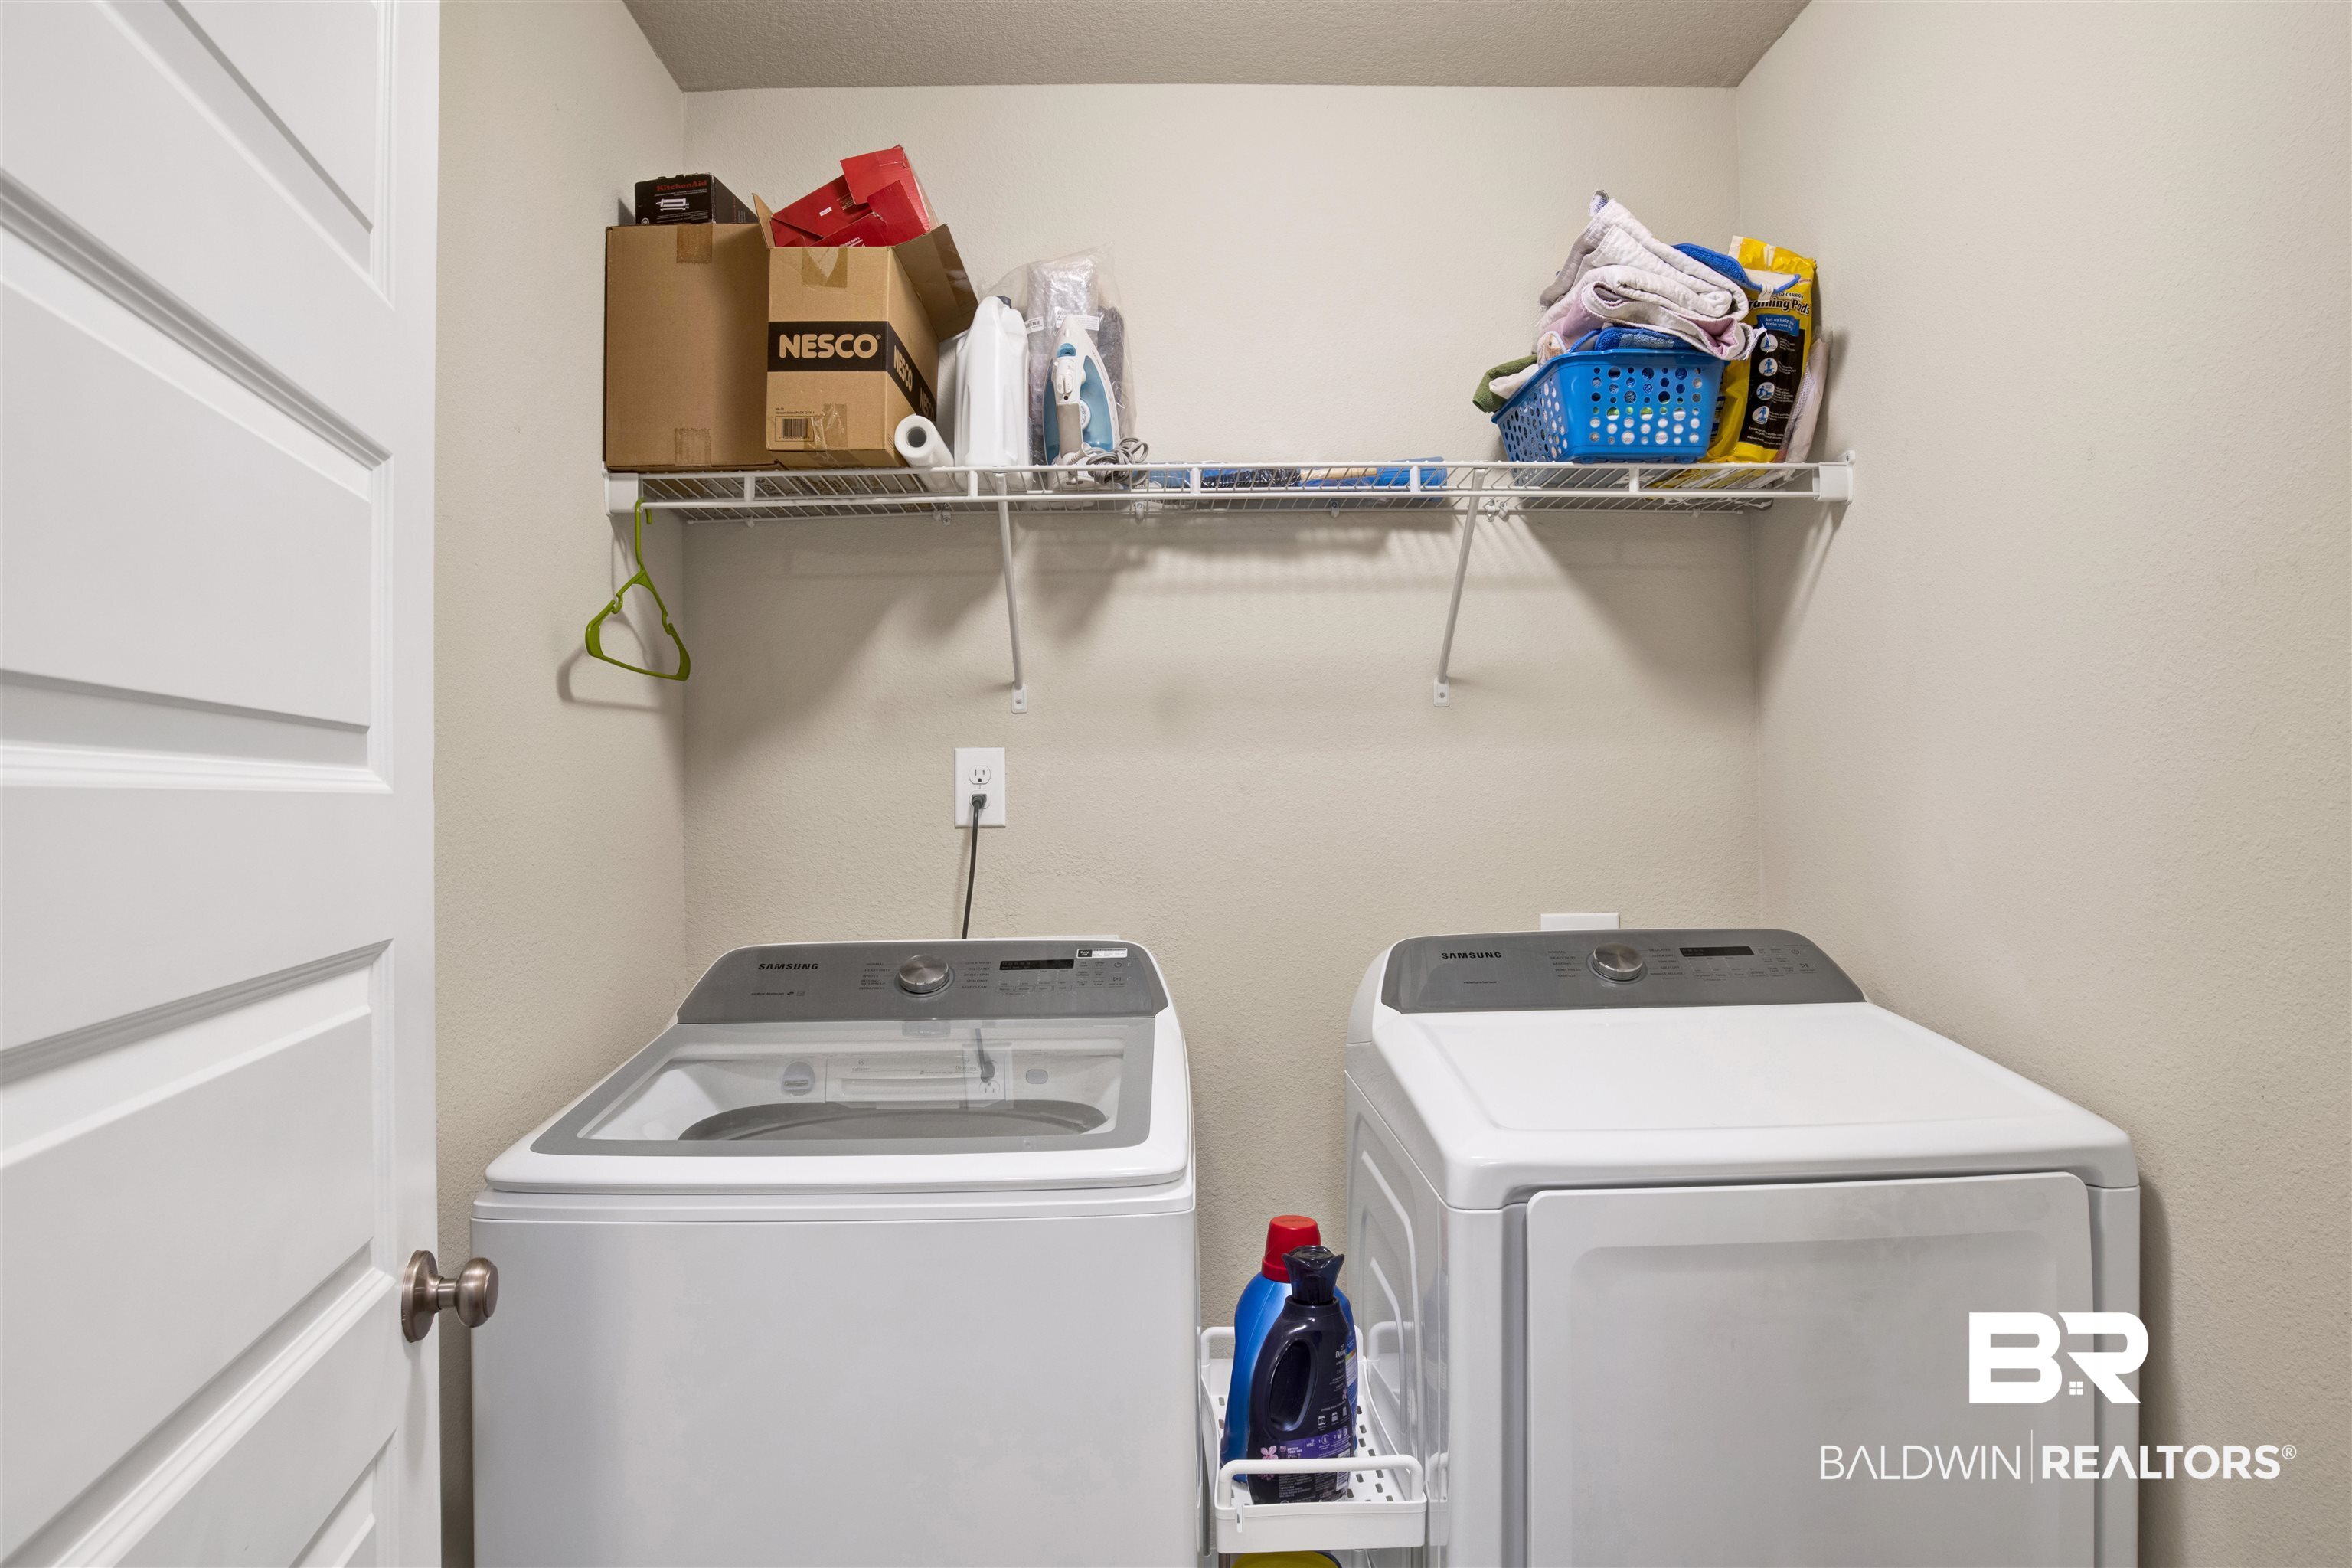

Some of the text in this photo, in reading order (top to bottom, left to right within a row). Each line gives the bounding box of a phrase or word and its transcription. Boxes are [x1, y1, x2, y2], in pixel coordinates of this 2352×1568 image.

[656, 179, 708, 191] KitchenAid
[1748, 297, 1811, 315] raining Pads
[893, 345, 913, 393] NESCO
